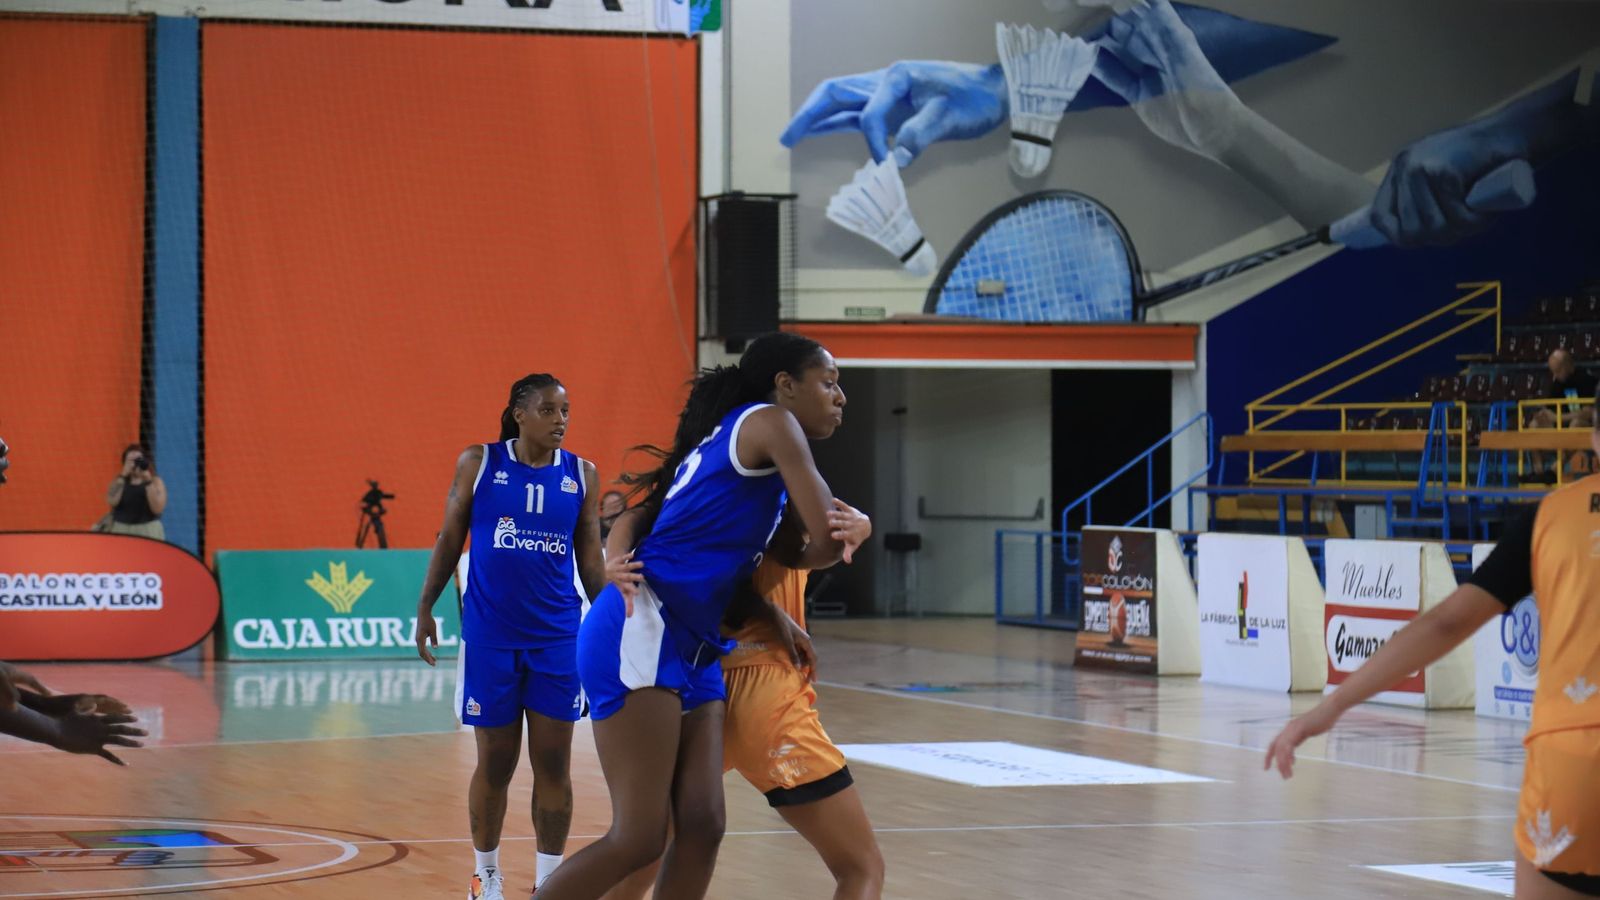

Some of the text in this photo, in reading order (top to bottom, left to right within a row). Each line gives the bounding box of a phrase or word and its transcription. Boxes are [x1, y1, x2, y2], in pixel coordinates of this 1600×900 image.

[525, 483, 544, 513] 11
[0, 577, 157, 589] BALONCESTO
[1342, 561, 1402, 600] Muebles
[0, 590, 157, 606] CASTILLA Y LEÓN
[1201, 612, 1286, 630] LA FÁBRICA DE LA LUZ
[233, 618, 326, 650] CAJA
